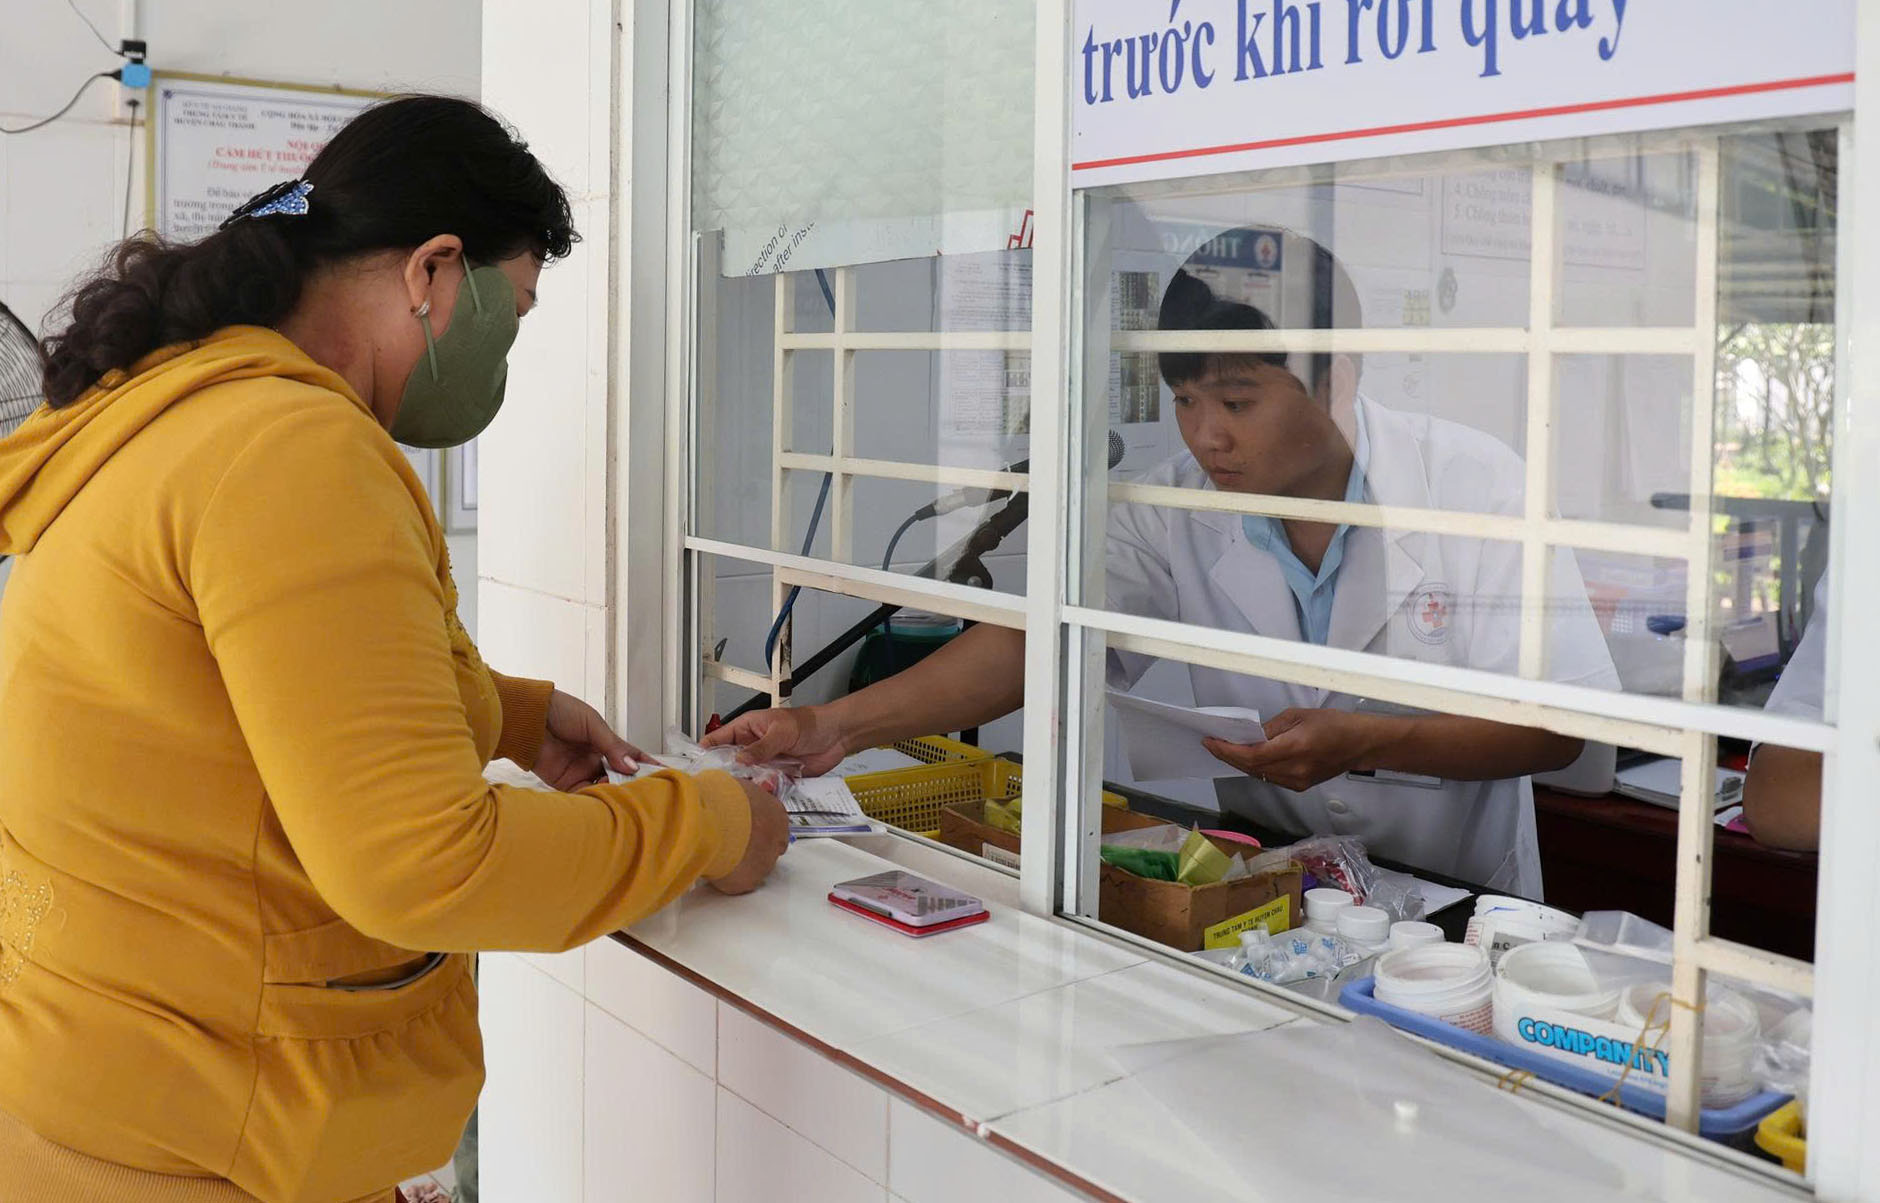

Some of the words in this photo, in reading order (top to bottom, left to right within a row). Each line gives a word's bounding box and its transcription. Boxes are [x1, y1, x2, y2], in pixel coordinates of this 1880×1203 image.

[1082, 0, 1216, 105] trước
[1233, 0, 1325, 82] khi
[792, 222, 815, 248] ins
